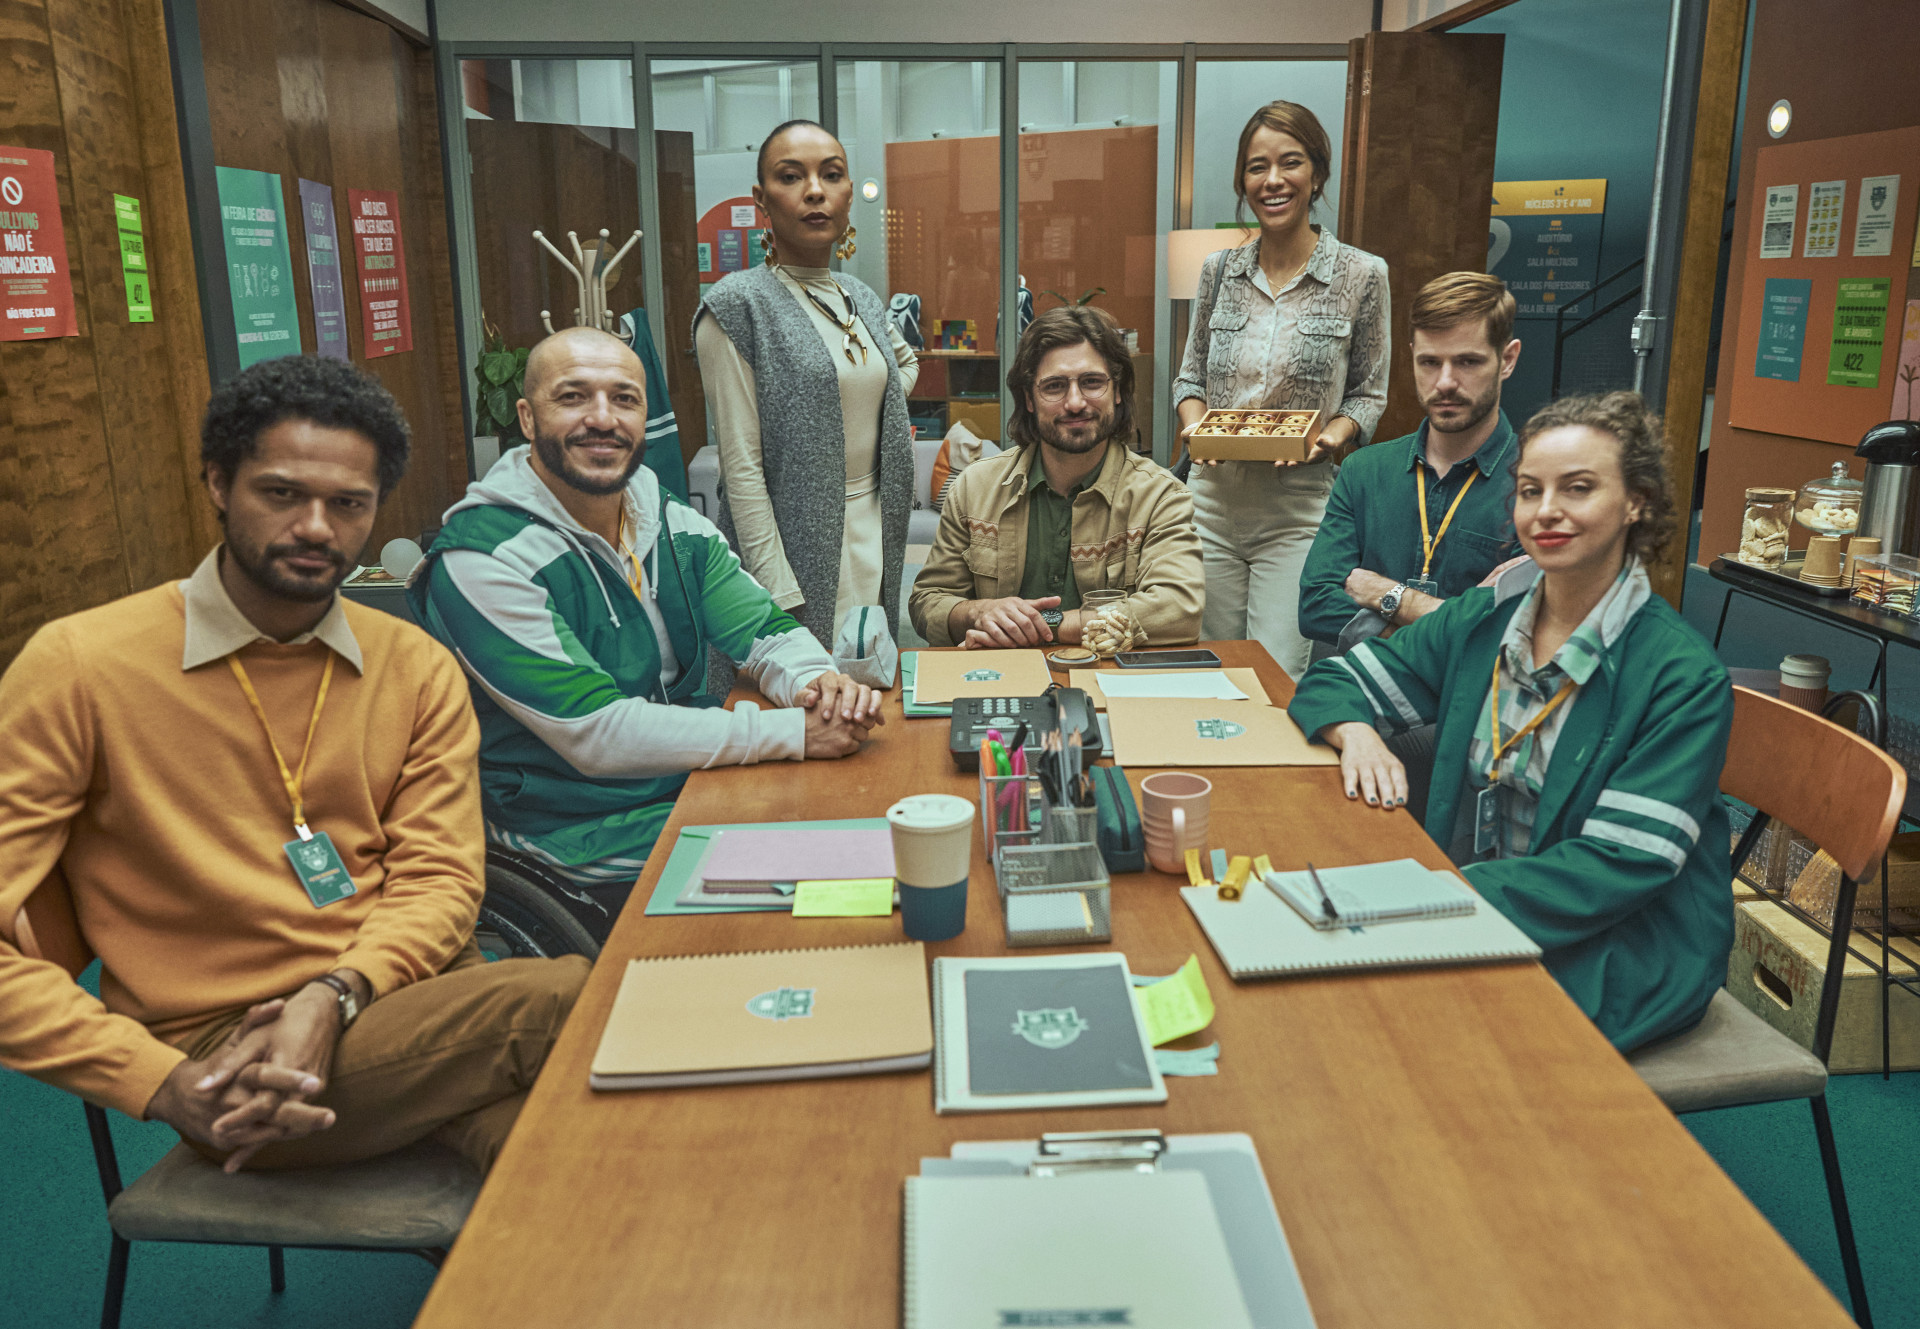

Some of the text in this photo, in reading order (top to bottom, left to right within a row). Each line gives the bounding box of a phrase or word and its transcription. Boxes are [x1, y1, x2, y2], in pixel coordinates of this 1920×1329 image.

[361, 198, 388, 216] NÃO BASTA
[1524, 198, 1554, 209] NÚCLEOS
[0, 211, 39, 230] ULLYING
[354, 216, 366, 234] NÃO
[4, 230, 35, 252] NÃO É
[0, 256, 56, 274] RINCADEIRA
[1527, 257, 1544, 267] SALA
[1511, 280, 1529, 290] SALA
[1529, 280, 1543, 290] DOS
[1518, 304, 1535, 313] SALA
[1536, 304, 1545, 313] DE
[1843, 352, 1864, 371] 422
